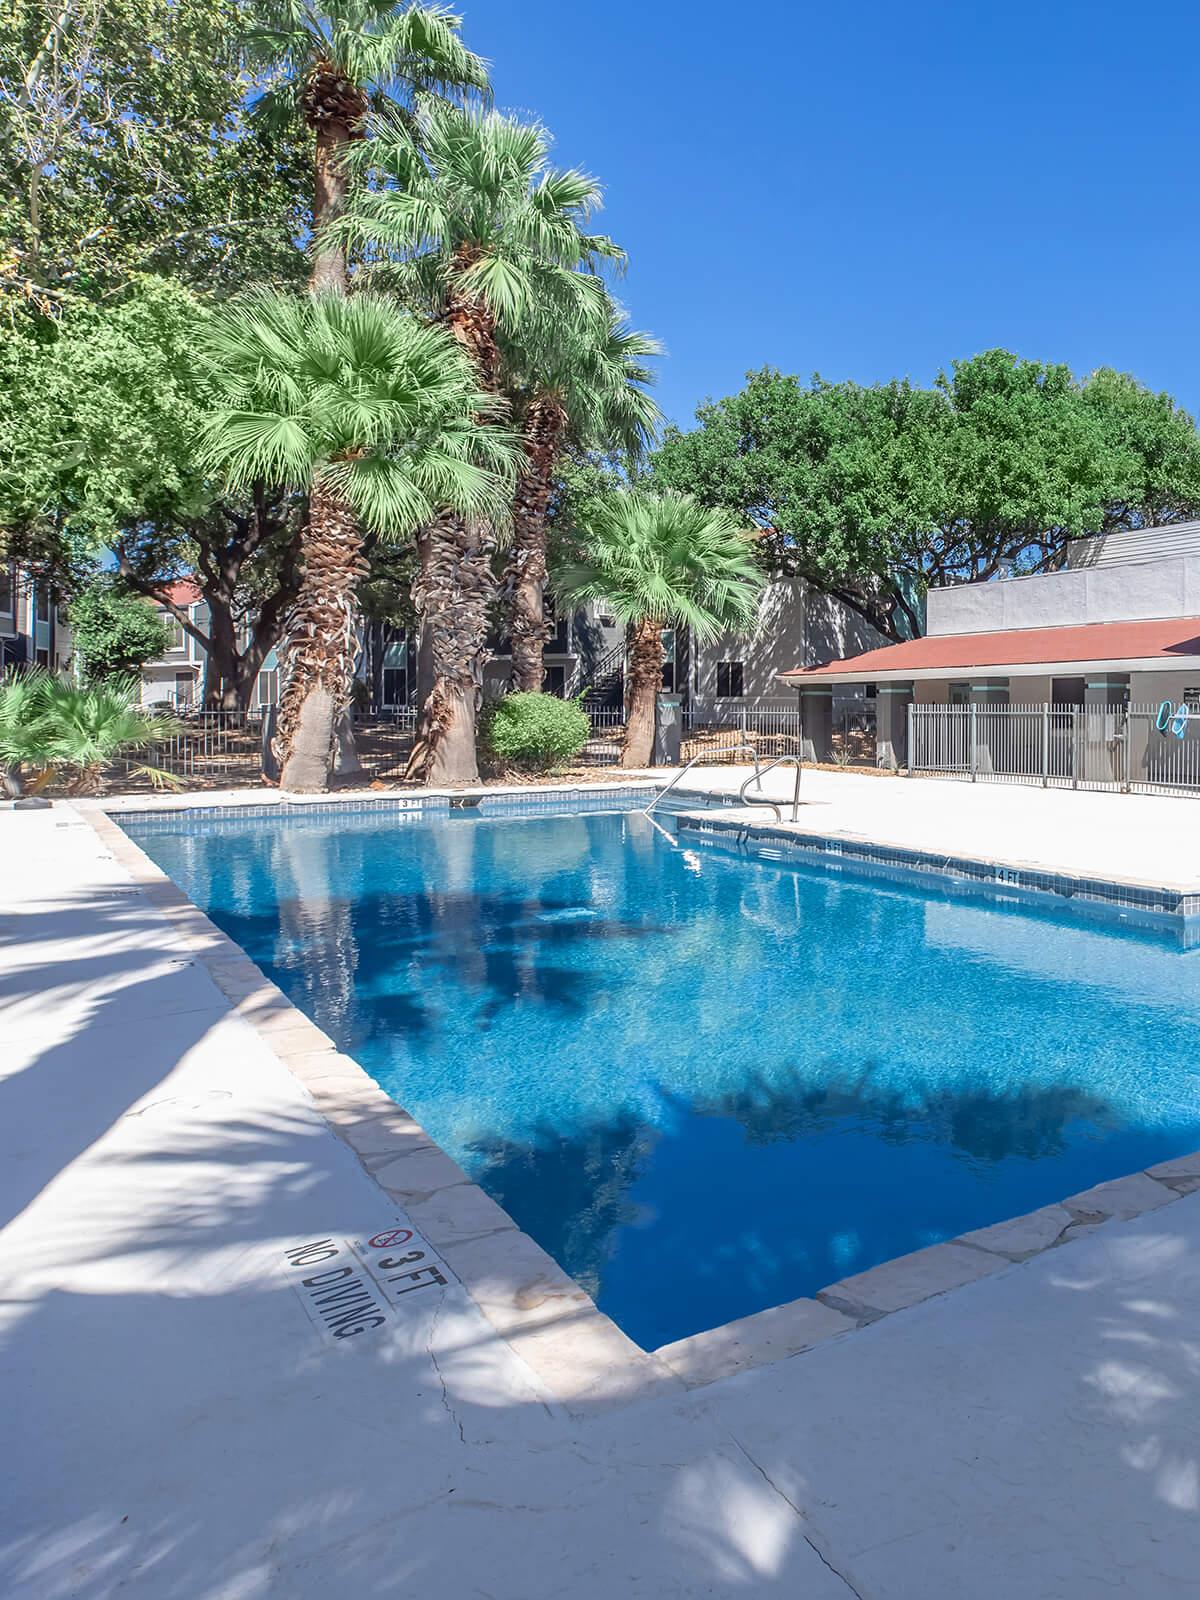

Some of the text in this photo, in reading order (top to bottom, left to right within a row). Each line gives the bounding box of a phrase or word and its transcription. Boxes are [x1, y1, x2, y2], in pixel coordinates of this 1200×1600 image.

[998, 869, 1018, 884] 4 FT
[284, 1238, 387, 1341] NO DIVING
[378, 1250, 449, 1295] 3 FT
